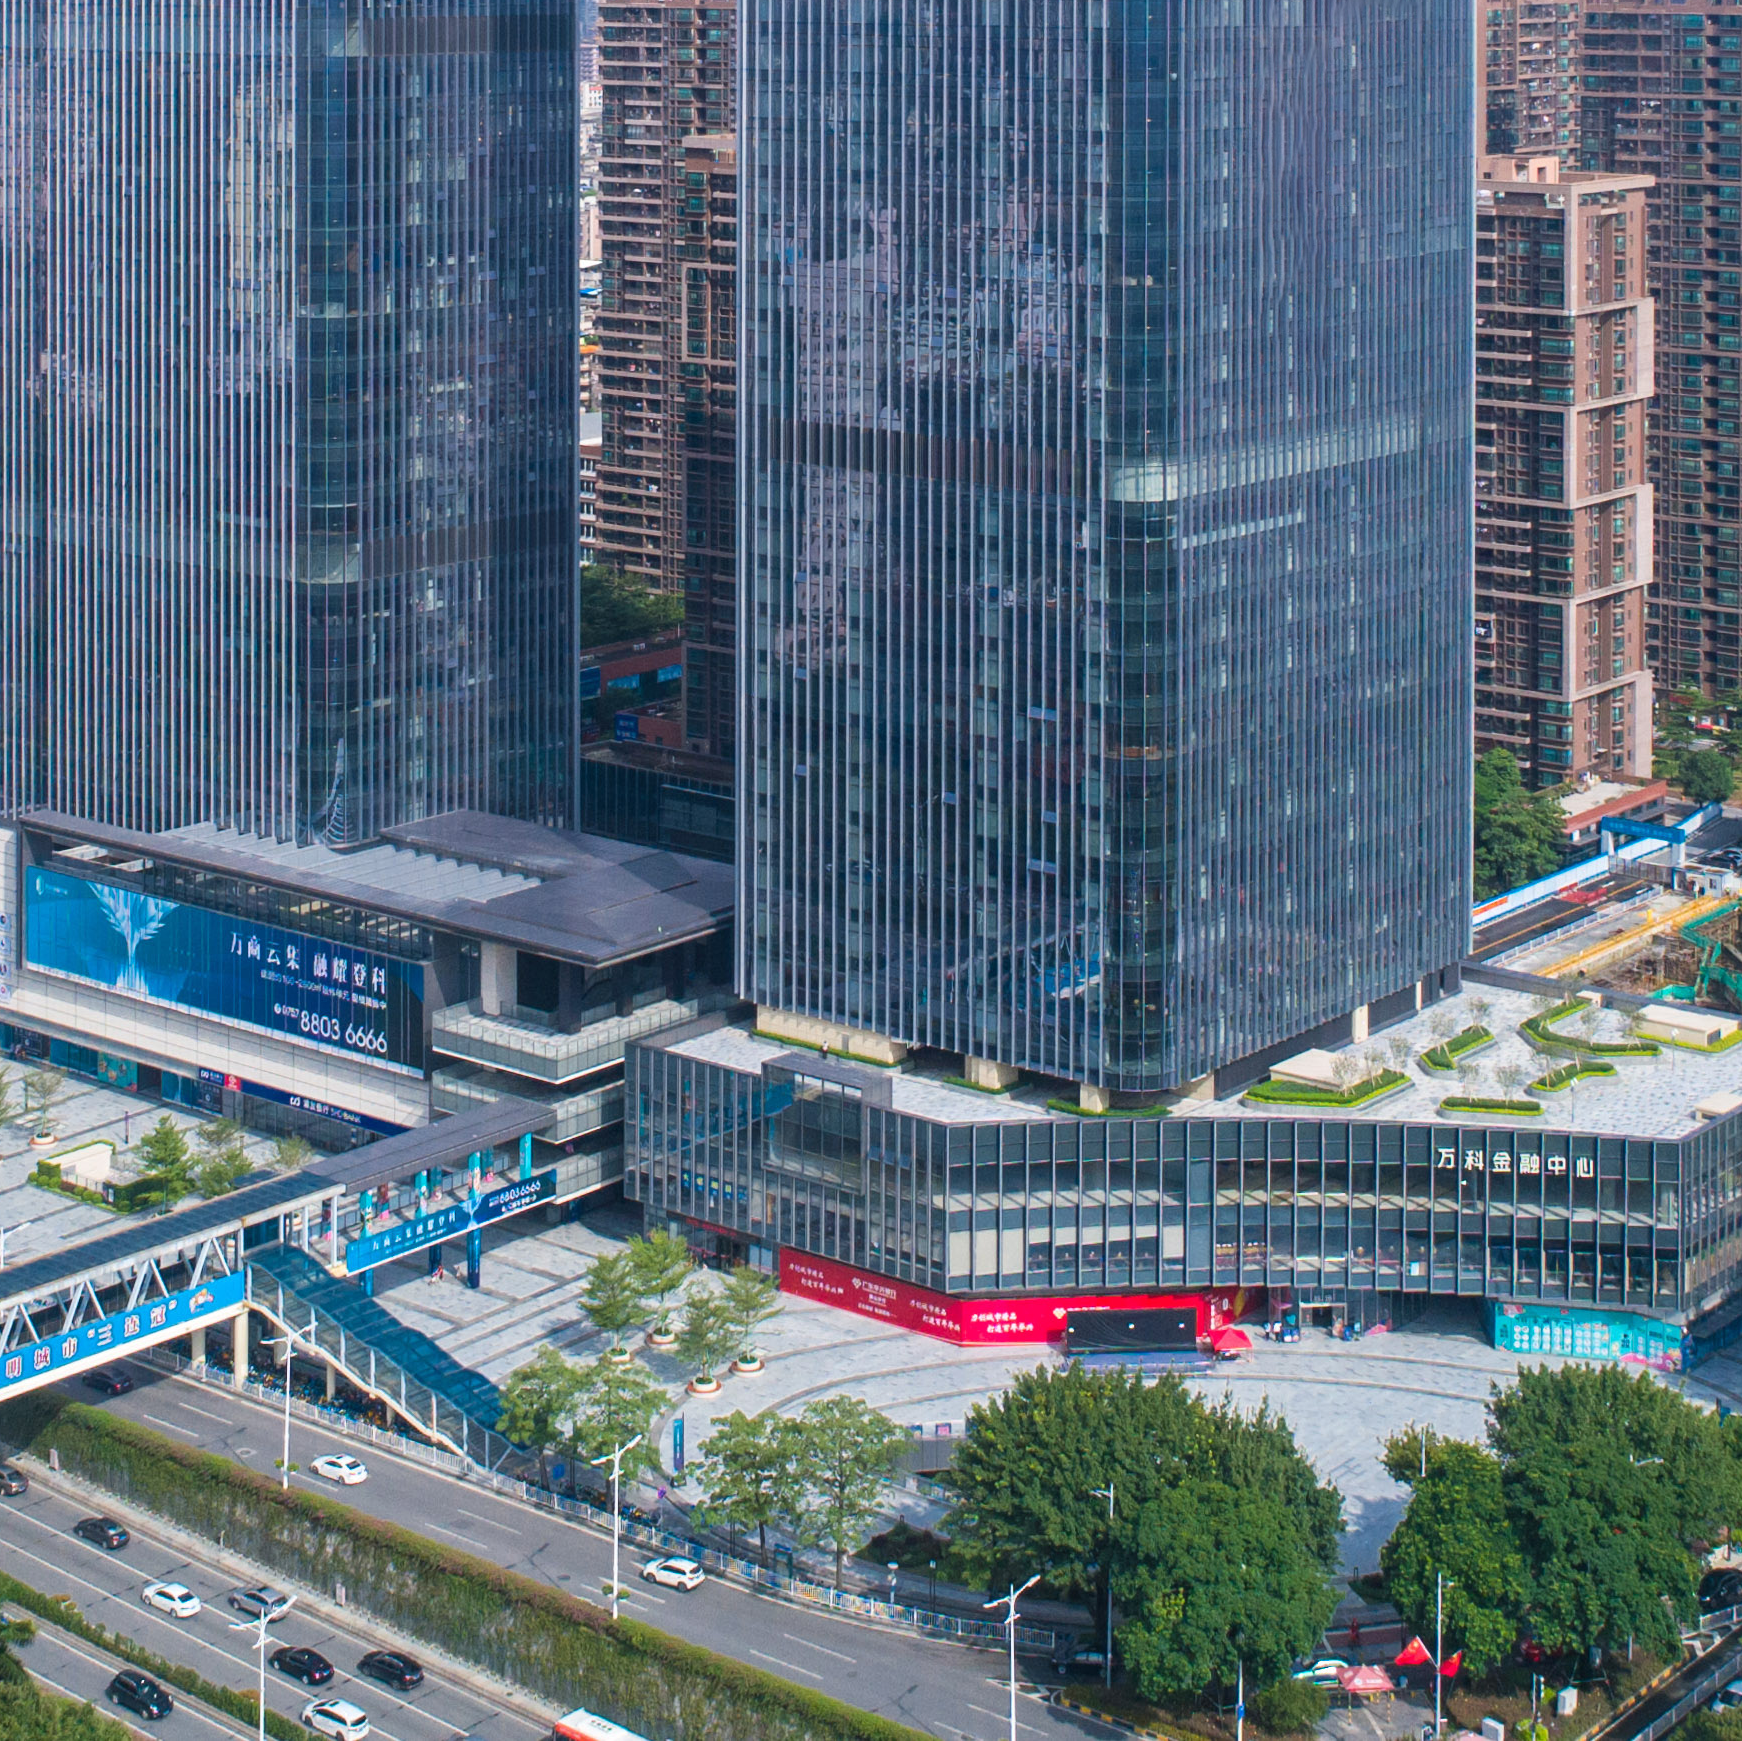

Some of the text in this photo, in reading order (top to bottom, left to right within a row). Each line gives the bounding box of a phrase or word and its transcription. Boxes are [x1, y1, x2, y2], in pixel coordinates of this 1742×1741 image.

[231, 931, 300, 970] 万商云集
[300, 1010, 341, 1041] 8803
[345, 1022, 388, 1054] 6666
[1437, 1147, 1594, 1178] 万科金融中心
